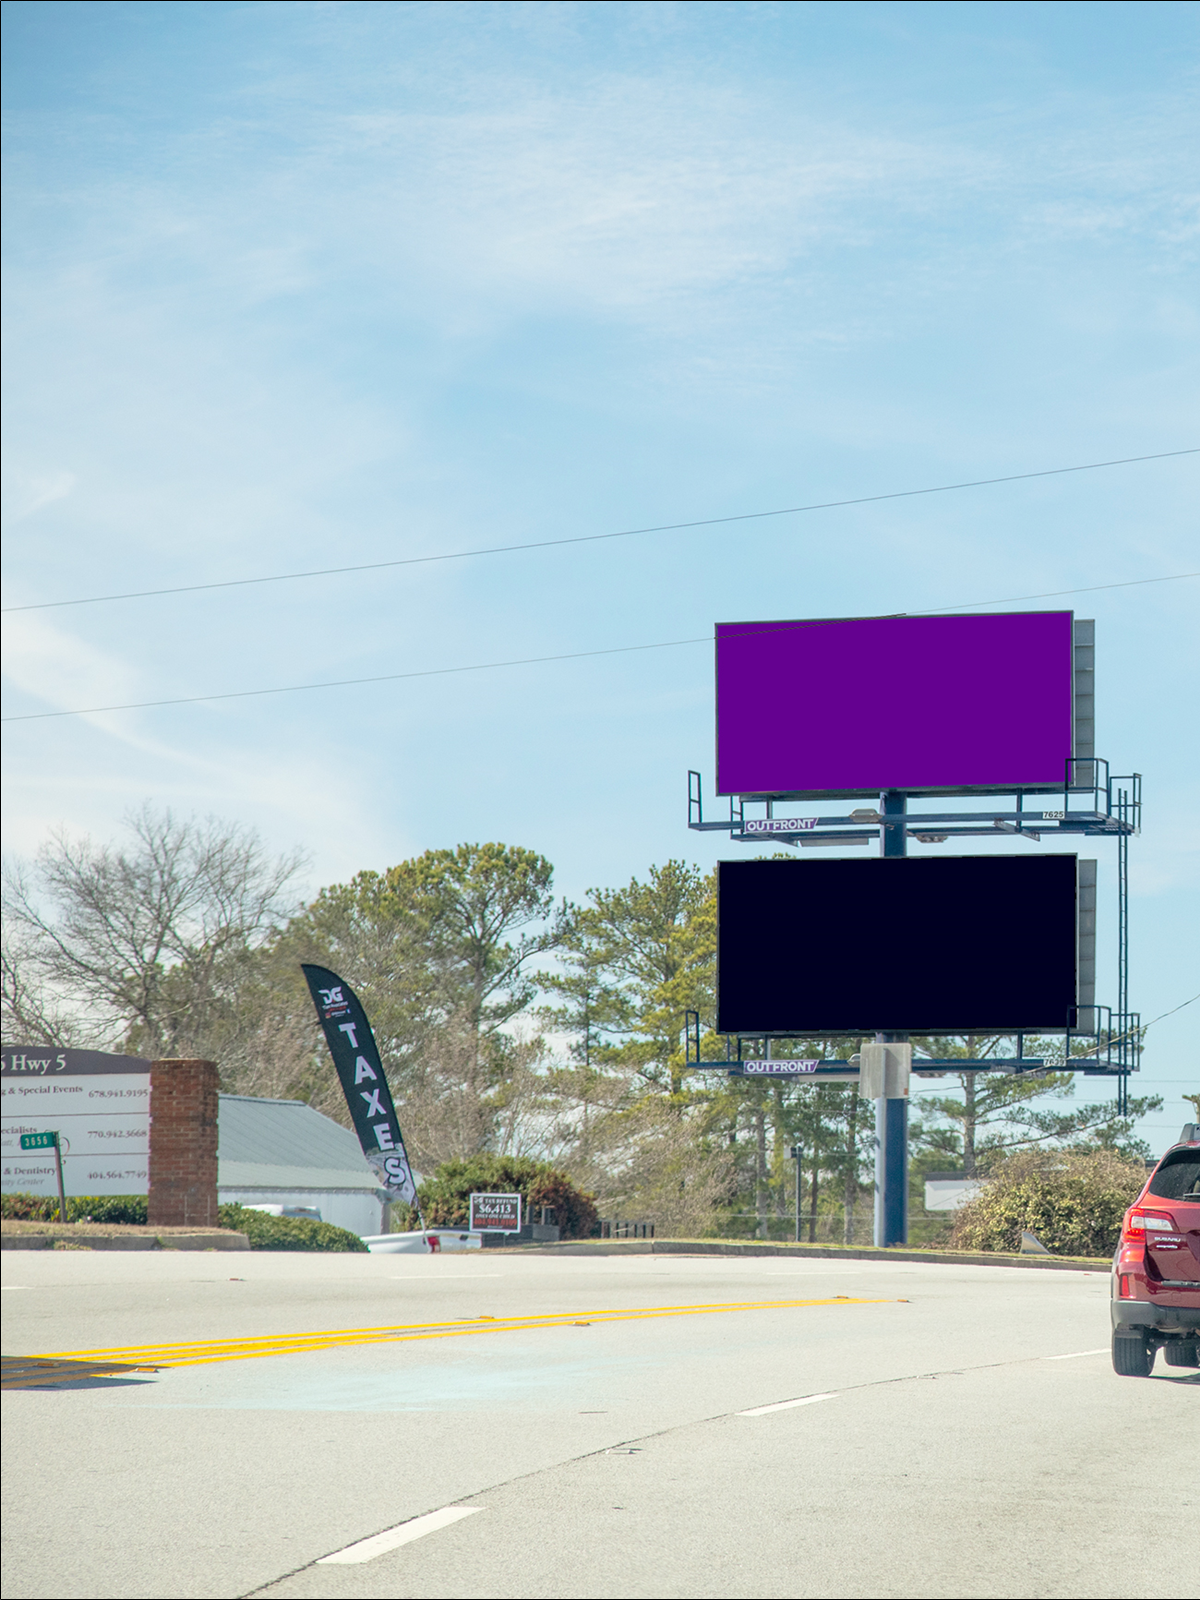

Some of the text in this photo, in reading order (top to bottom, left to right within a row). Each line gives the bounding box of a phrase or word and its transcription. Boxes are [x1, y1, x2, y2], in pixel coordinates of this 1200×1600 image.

[747, 819, 814, 831] OUTFRONT
[10, 1054, 52, 1075] Hwy
[56, 1054, 67, 1071] 5
[746, 1061, 814, 1072] OUTFRONT
[18, 1086, 51, 1096] Special
[53, 1085, 83, 1094] Events
[338, 1022, 406, 1185] TAXES
[24, 1135, 48, 1147] 3656
[14, 1166, 56, 1176] Dentistry
[478, 1203, 512, 1215] $6,413
